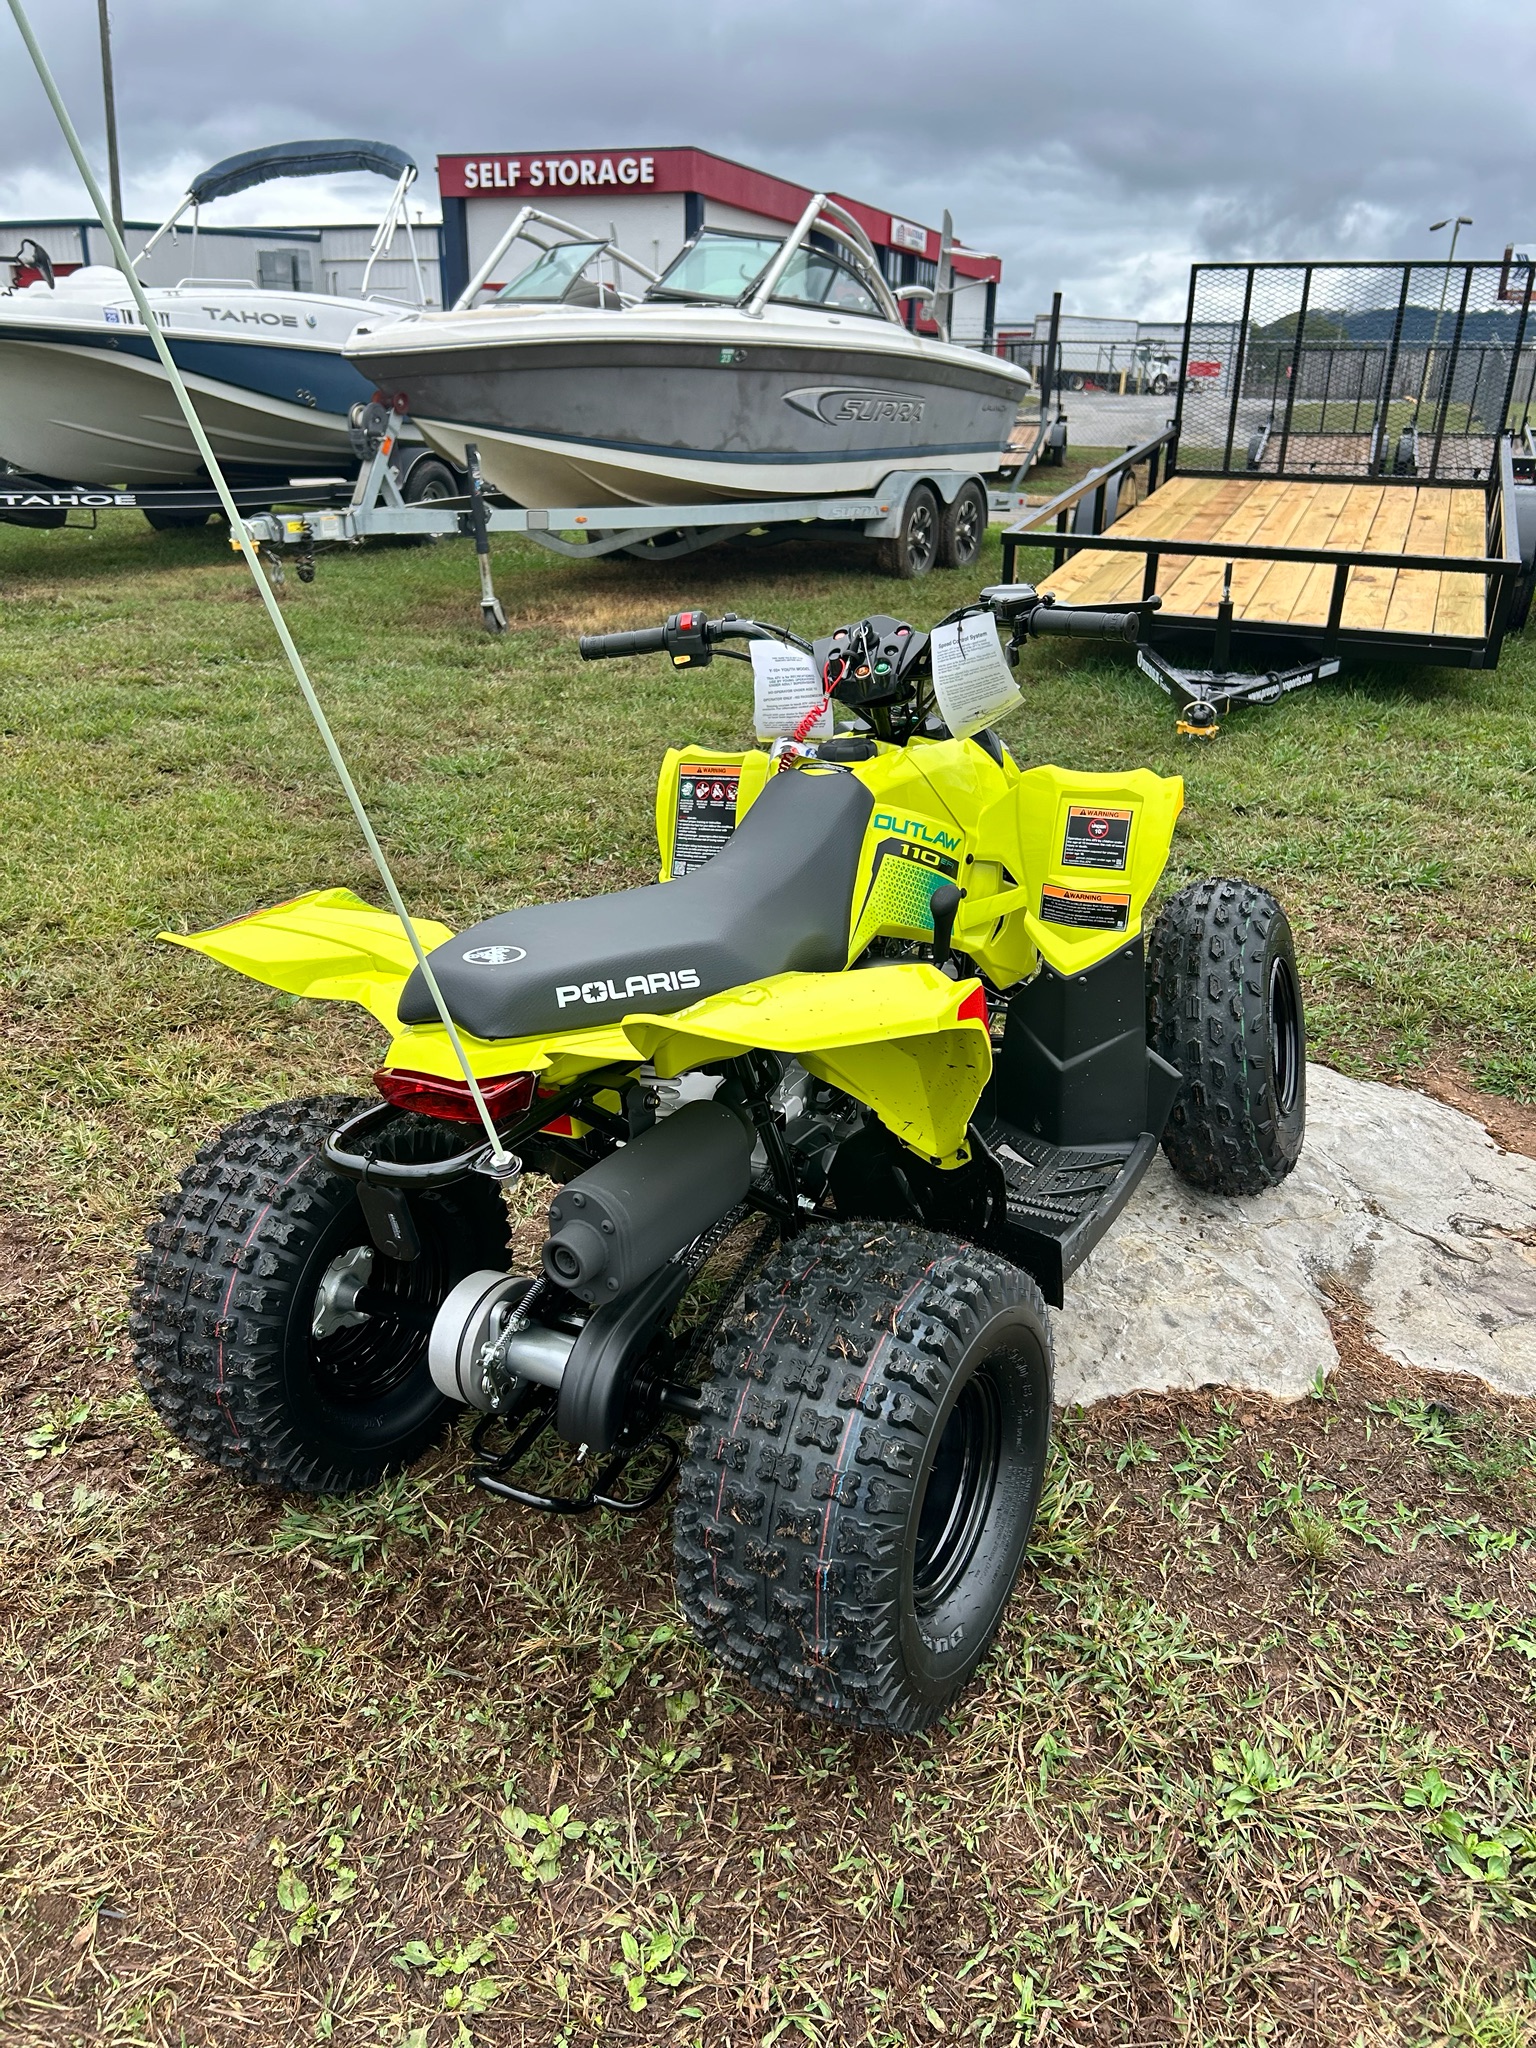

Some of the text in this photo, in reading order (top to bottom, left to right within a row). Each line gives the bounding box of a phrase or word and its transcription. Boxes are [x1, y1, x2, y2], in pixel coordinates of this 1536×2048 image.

[464, 157, 655, 189] SELF STORAGE
[202, 306, 299, 328] TAHOE
[835, 399, 926, 424] SUPRA
[0, 494, 137, 506] TAHOE
[1087, 809, 1119, 818] WARNING
[873, 813, 962, 852] OUTLAW
[901, 843, 940, 866] 110
[1069, 892, 1102, 902] WARNING
[555, 968, 701, 1009] POLARIS
